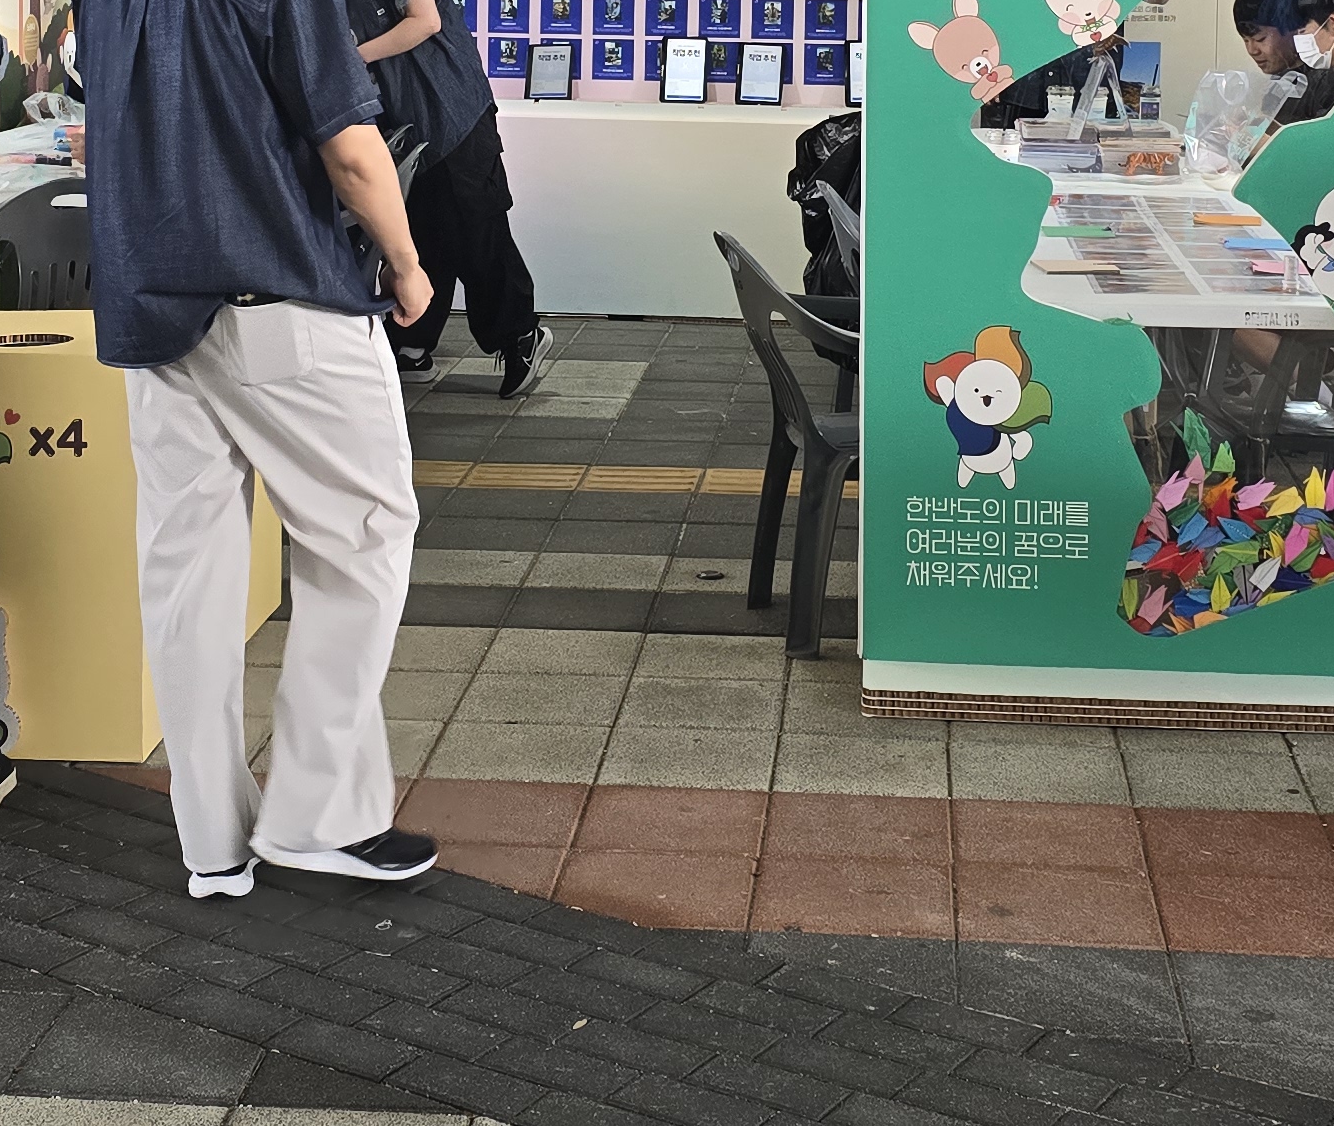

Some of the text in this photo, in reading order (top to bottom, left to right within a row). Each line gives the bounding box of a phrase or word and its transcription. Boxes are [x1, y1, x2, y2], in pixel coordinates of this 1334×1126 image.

[672, 48, 701, 57] 직업 추천
[748, 53, 777, 63] 직업 추천
[28, 418, 88, 457] x4
[906, 495, 1089, 527] 한반도의 미래를
[906, 528, 1089, 559] 여러분의 꿈으로
[906, 560, 1039, 590] 채워주세요!
